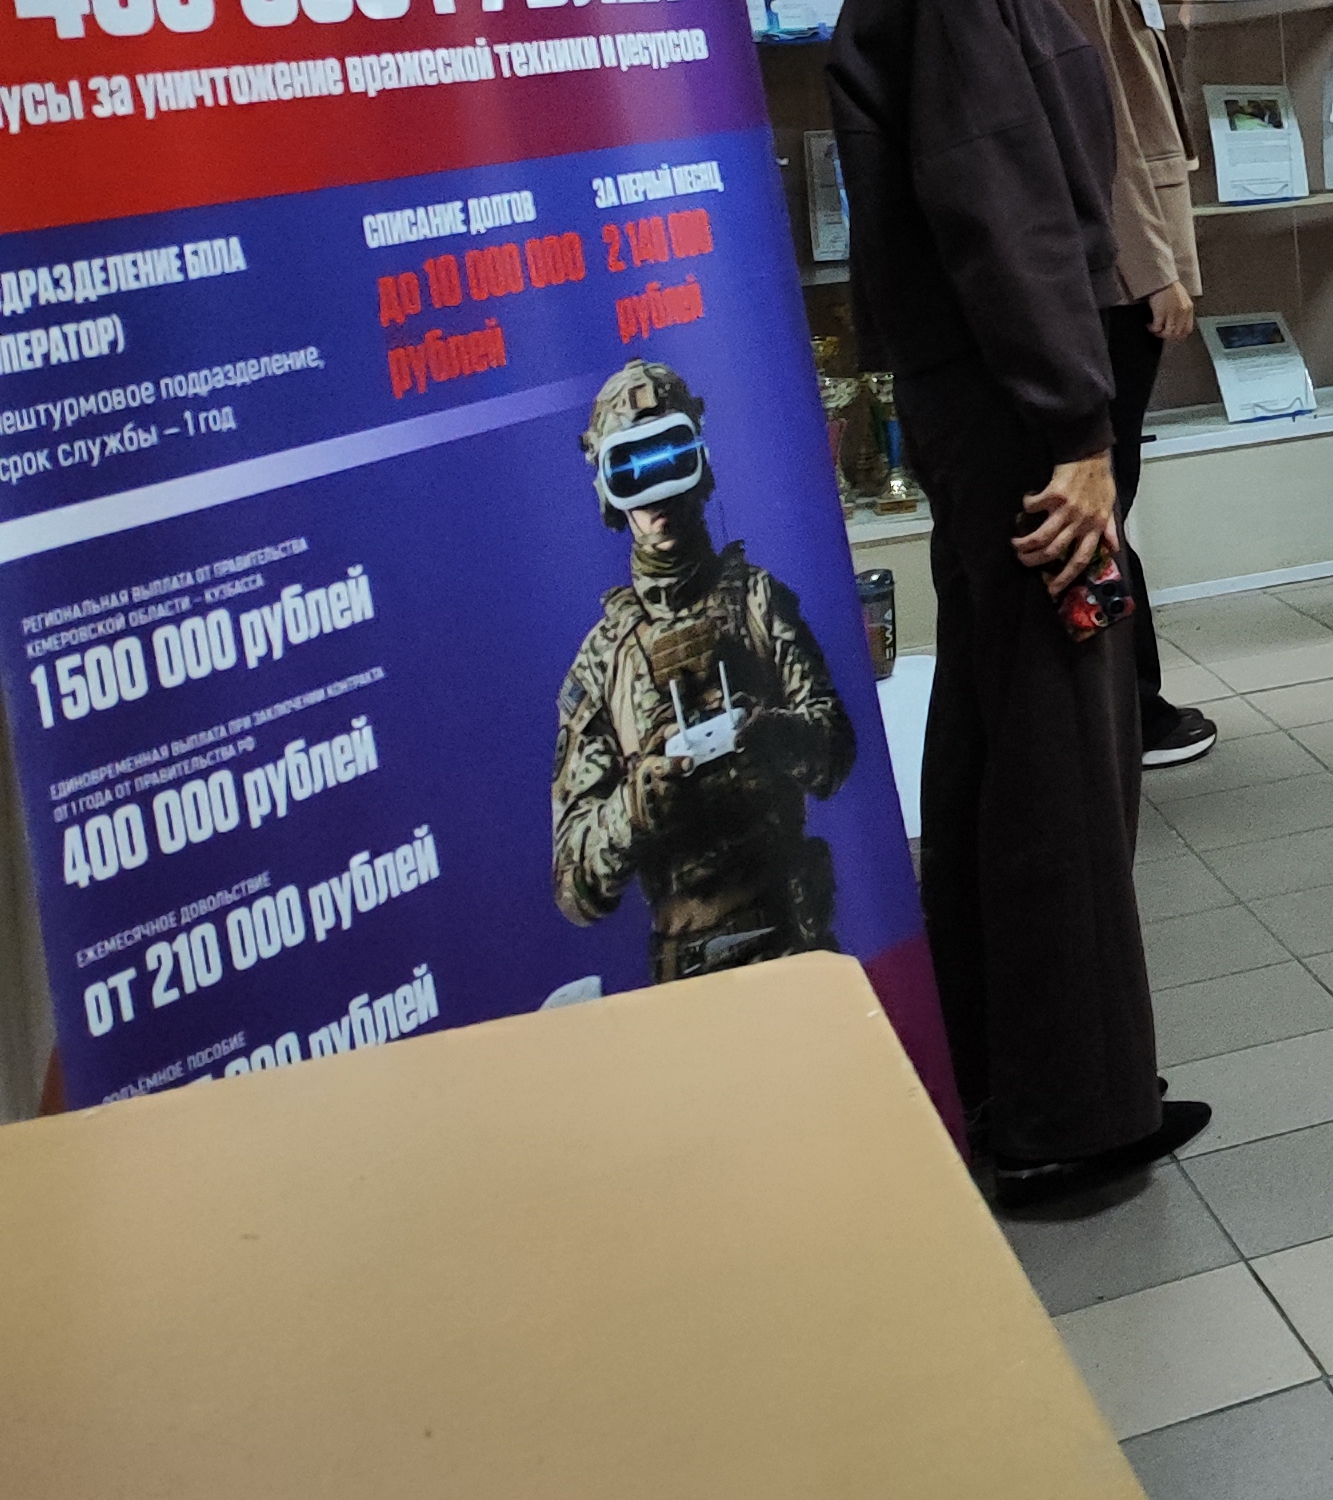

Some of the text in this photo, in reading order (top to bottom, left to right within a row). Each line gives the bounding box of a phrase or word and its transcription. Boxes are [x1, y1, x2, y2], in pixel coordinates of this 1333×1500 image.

[0, 28, 709, 134] усы за уничтожение вражеской техники и ресурсов
[363, 190, 537, 248] СПИСАНИЕ ДОЛГОВ
[592, 176, 618, 208] ЗА
[0, 236, 247, 316] ДРАЗДЕЛЕНИЕ БПЛА
[603, 223, 627, 272] 2
[378, 272, 421, 328] до
[423, 255, 462, 309] 10
[0, 313, 125, 376] ПЕРАТОР)
[387, 317, 506, 399] рублей
[0, 346, 325, 436] ештурмовое подразделение,
[0, 447, 52, 485] срок
[57, 421, 158, 466] службы
[184, 410, 195, 436] 1
[198, 406, 236, 433] год
[21, 537, 309, 635] РЕГИОНАЛЬНАЯ ВЫПЛАТА ОТ ПРАВИТЕЛЬСТВА
[25, 612, 127, 659] КЕМЕРОВСКОЙ
[128, 595, 191, 626] ОБЛАСТИ
[203, 573, 265, 604] КУЗБАССА
[30, 564, 375, 729] 1 500 000 рублей
[50, 745, 170, 801] ЕДИНОВРЕМЕННАЯ
[170, 722, 227, 756] ВЫПЛАТА
[229, 713, 252, 736] ПРИ
[53, 804, 71, 823] ОТ
[78, 789, 113, 814] ГОДА
[114, 783, 132, 802] ОТ
[134, 744, 236, 792] ПРАВИТЕЛЬСТВА
[237, 736, 256, 755] РФ
[63, 714, 378, 889] 400 000 рублей
[75, 870, 272, 968] ЕЖЕМЕСЯЧНОЕ ДОВОЛЬСТВИЕ
[145, 922, 223, 1009] 210
[226, 884, 306, 971] 000
[308, 824, 440, 942] рублей
[187, 1030, 247, 1071] ПОСОБИЕ
